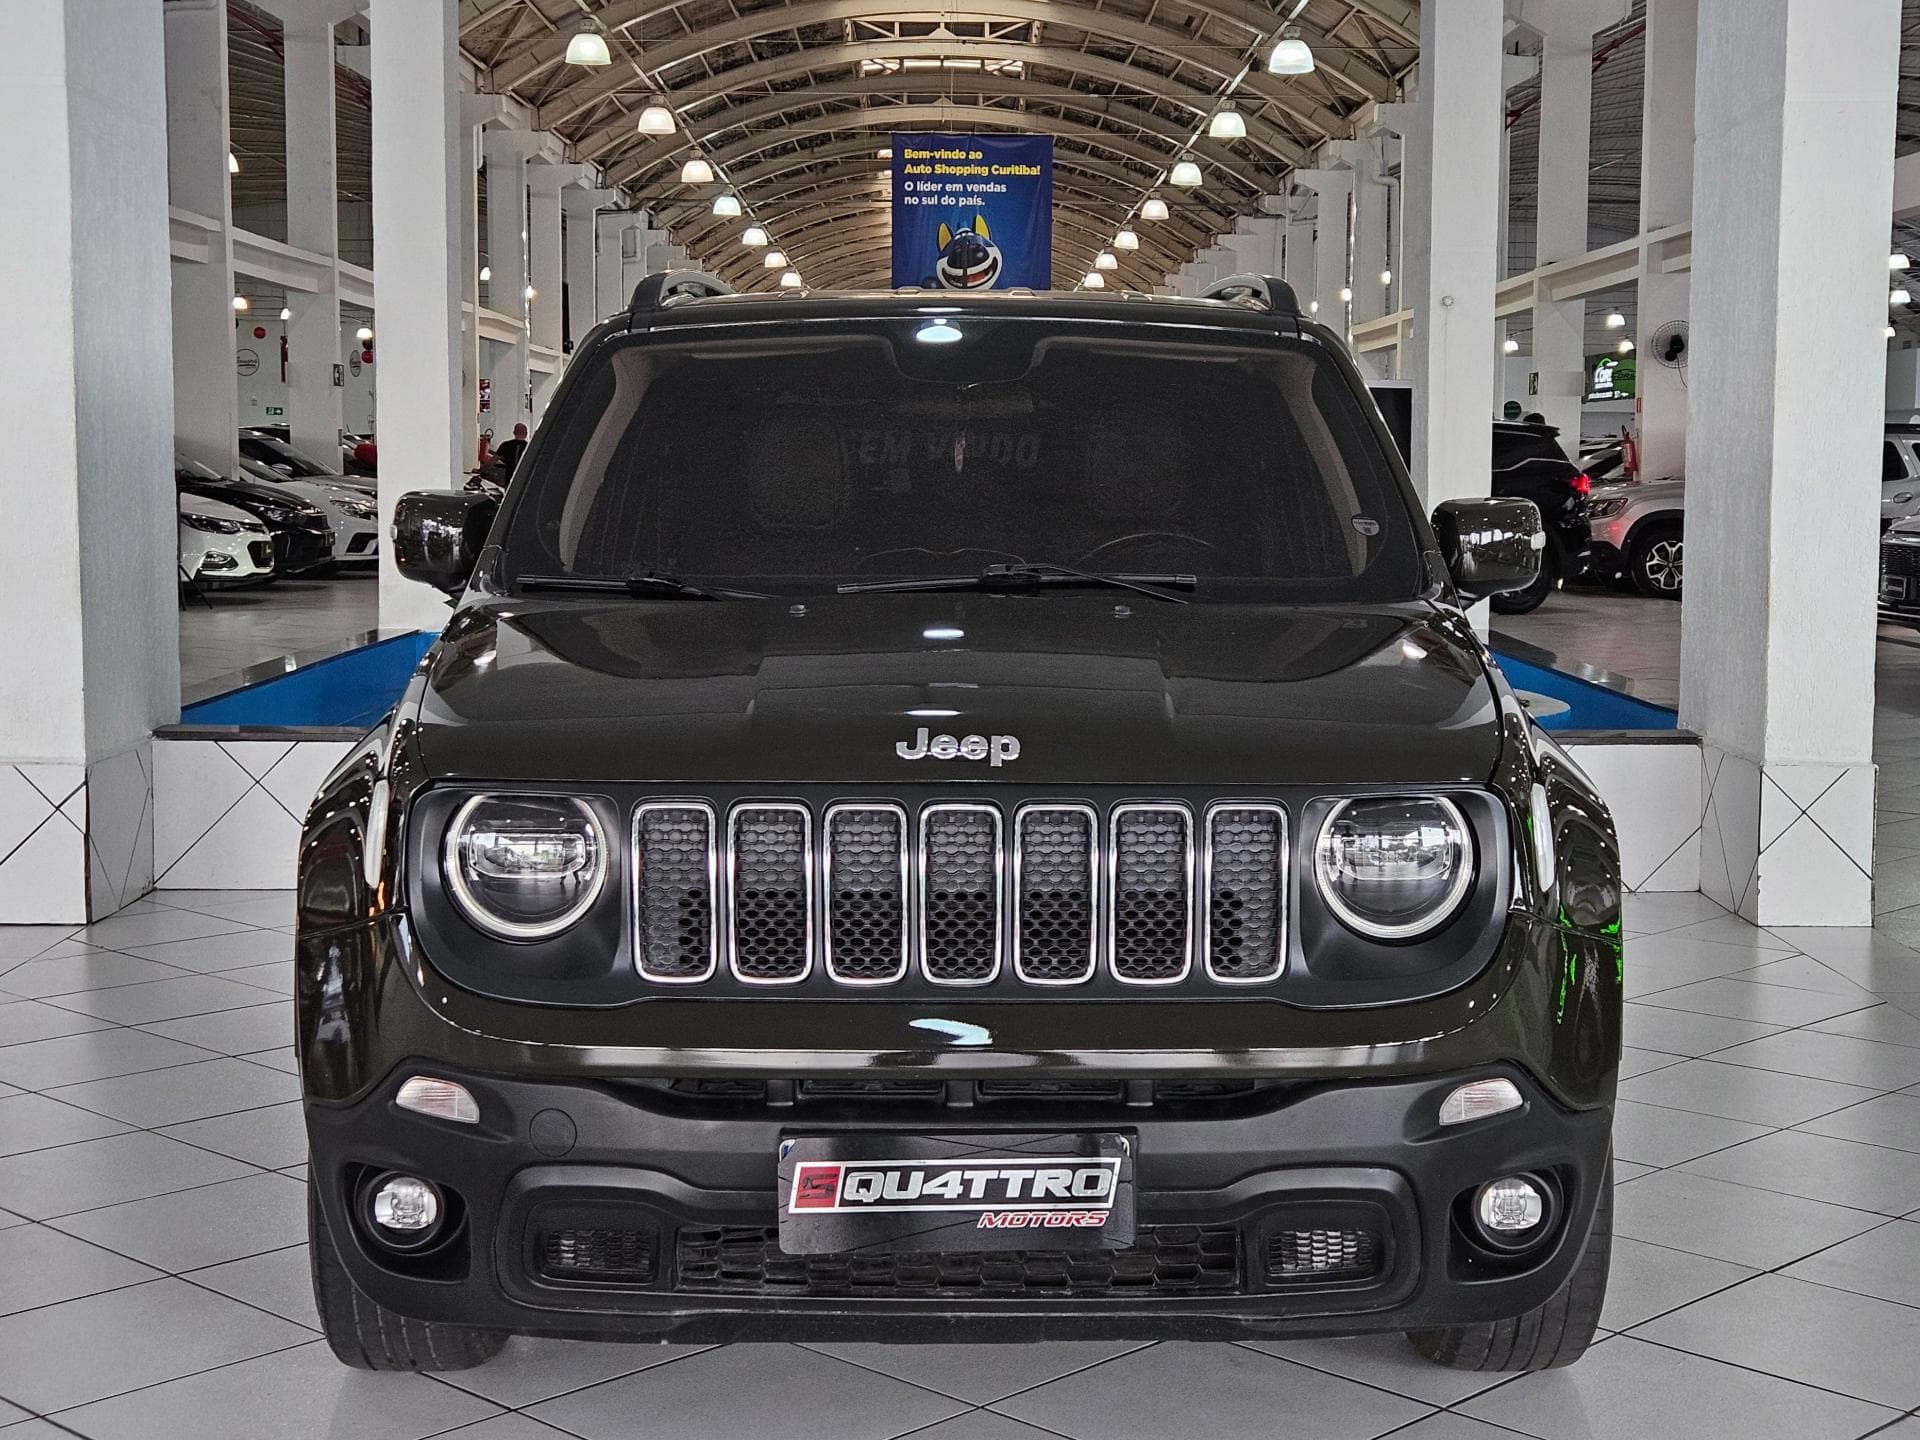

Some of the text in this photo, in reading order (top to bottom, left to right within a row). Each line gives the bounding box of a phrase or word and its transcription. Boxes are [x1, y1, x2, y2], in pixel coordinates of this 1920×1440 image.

[904, 149, 983, 160] Bem-vindo ao
[904, 164, 1041, 176] Auto Shopping Curitiba!
[904, 180, 1007, 193] O líder em vendas
[904, 194, 986, 207] no sul do país.
[896, 727, 1021, 767] Jeep
[842, 1167, 1113, 1202] QU4TTRO
[976, 1210, 1110, 1229] MOTORS
